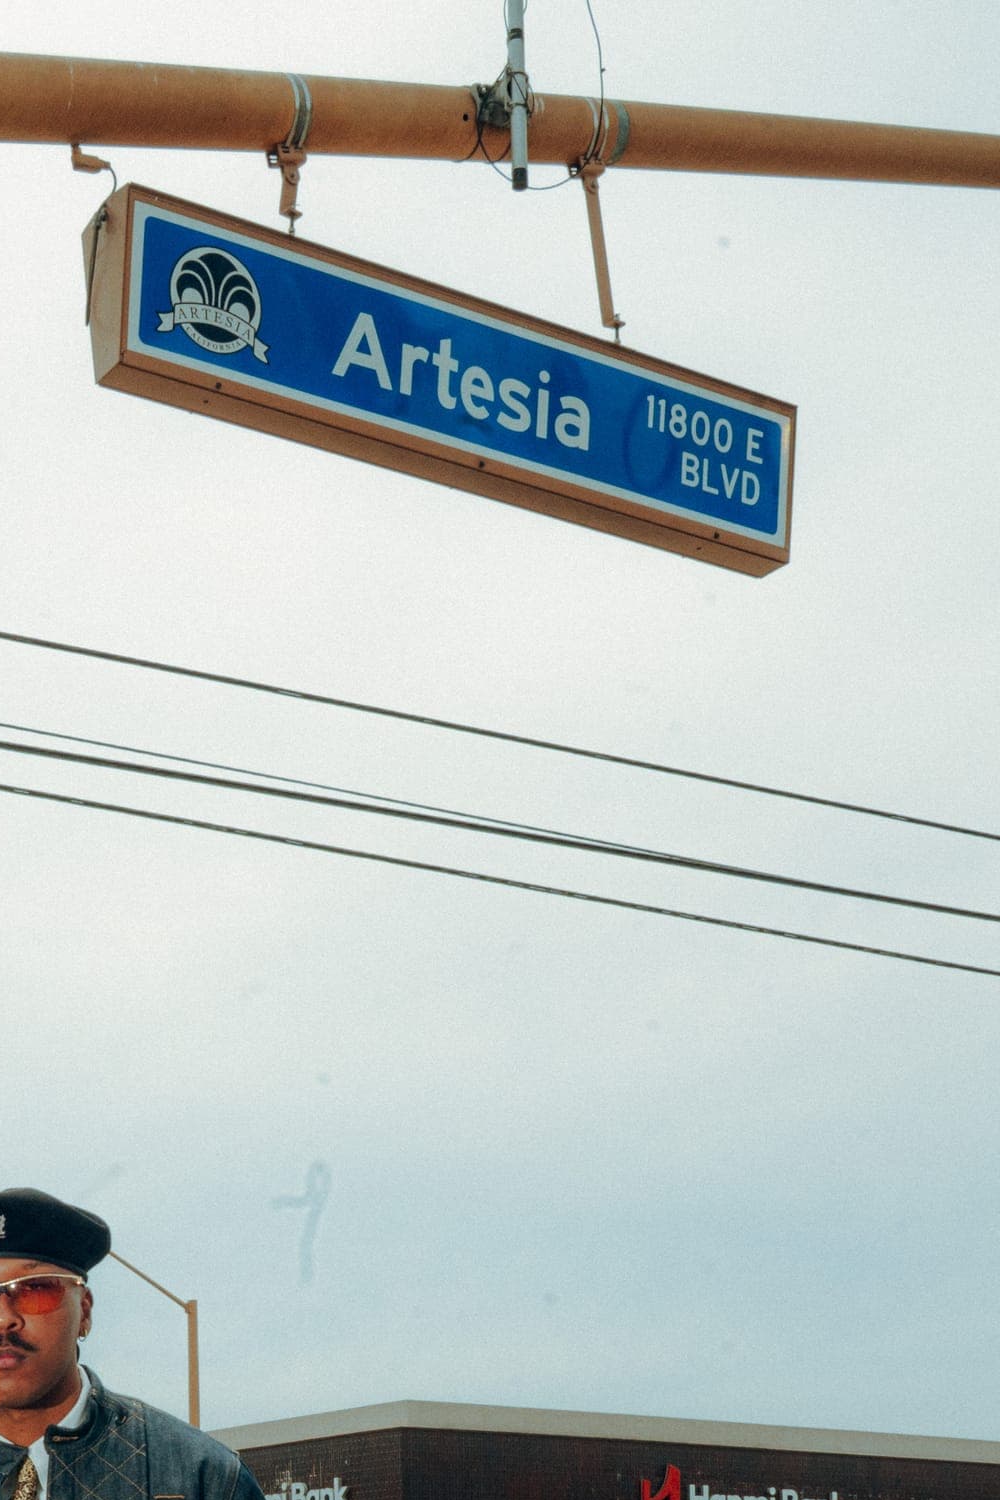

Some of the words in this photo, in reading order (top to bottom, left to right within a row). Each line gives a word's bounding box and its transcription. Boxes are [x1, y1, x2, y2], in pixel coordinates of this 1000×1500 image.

[178, 306, 252, 341] ARTESIA
[185, 325, 243, 351] CALIFORNIA
[331, 311, 591, 452] Artesia
[646, 394, 733, 454] 11800
[745, 427, 764, 465] E
[680, 450, 761, 506] BLVD
